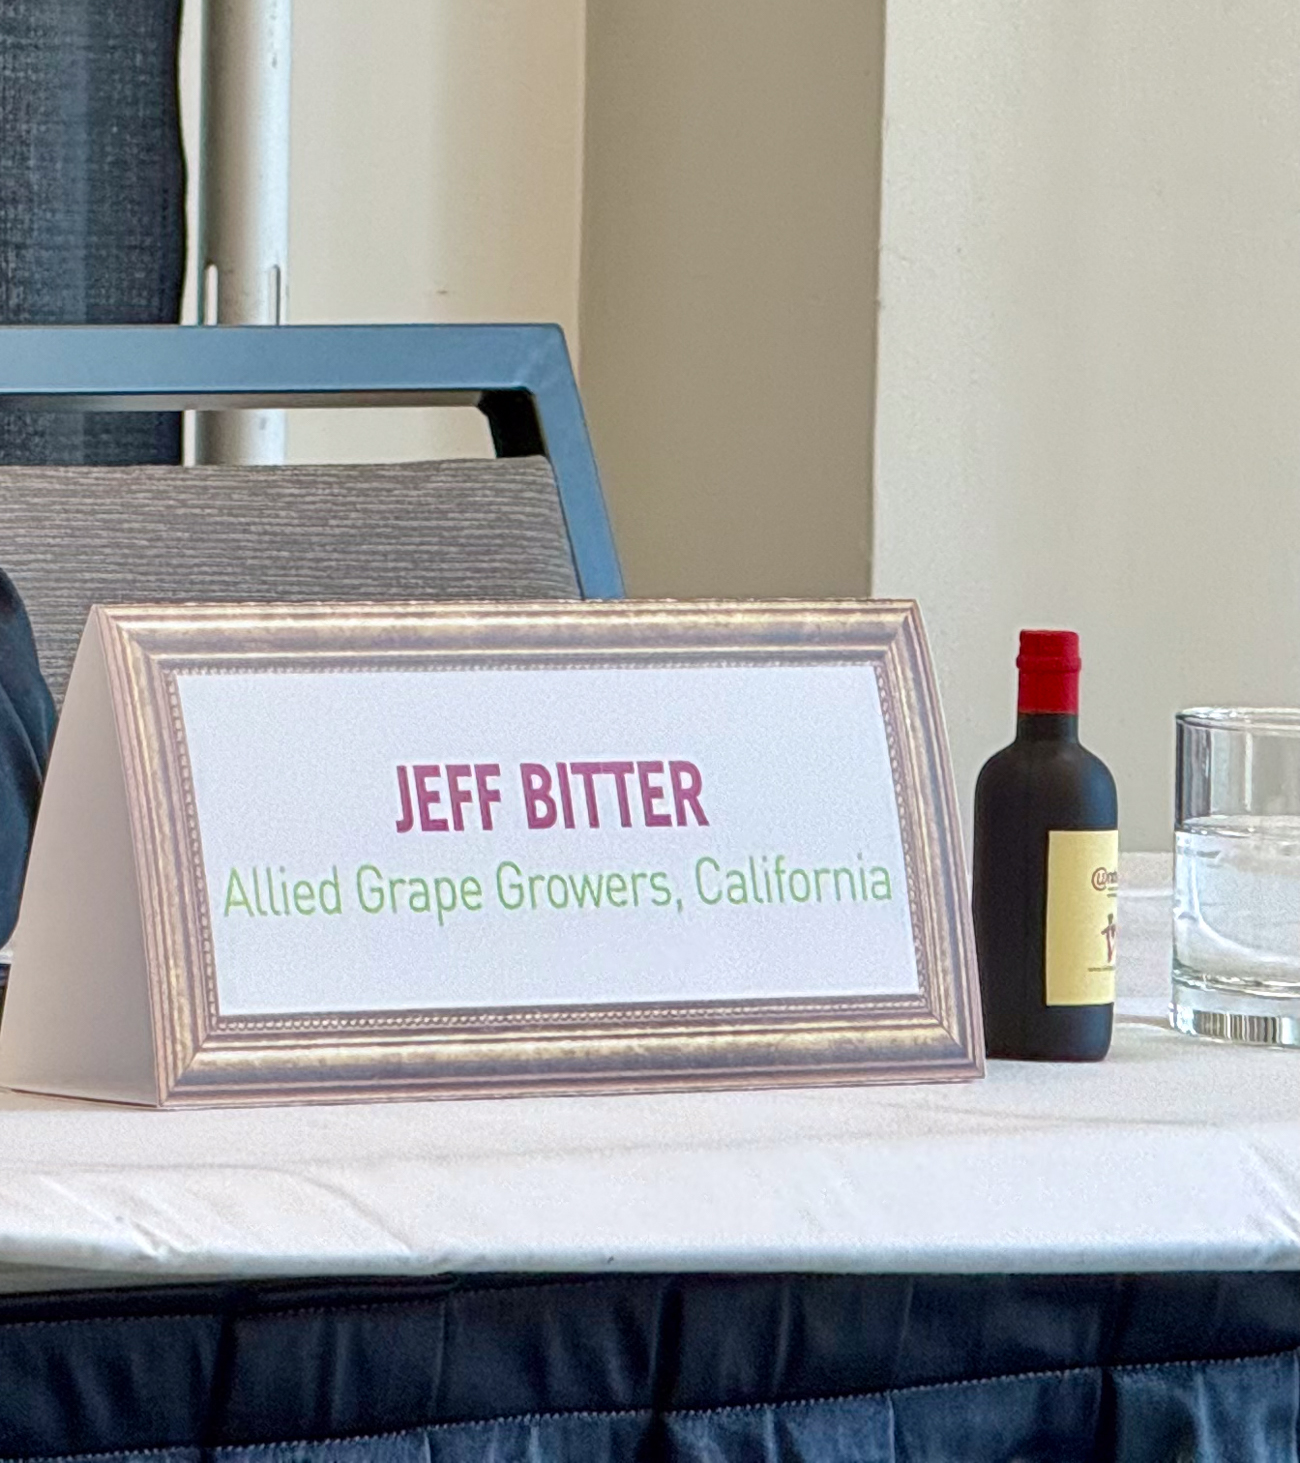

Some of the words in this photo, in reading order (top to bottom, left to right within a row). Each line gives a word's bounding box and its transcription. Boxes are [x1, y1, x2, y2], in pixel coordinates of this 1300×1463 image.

[396, 763, 501, 833] JEFF
[520, 760, 710, 829] BITTER
[223, 866, 342, 918] Allied
[356, 864, 484, 926] Grape
[495, 861, 684, 914] Growers,
[695, 853, 893, 905] California
